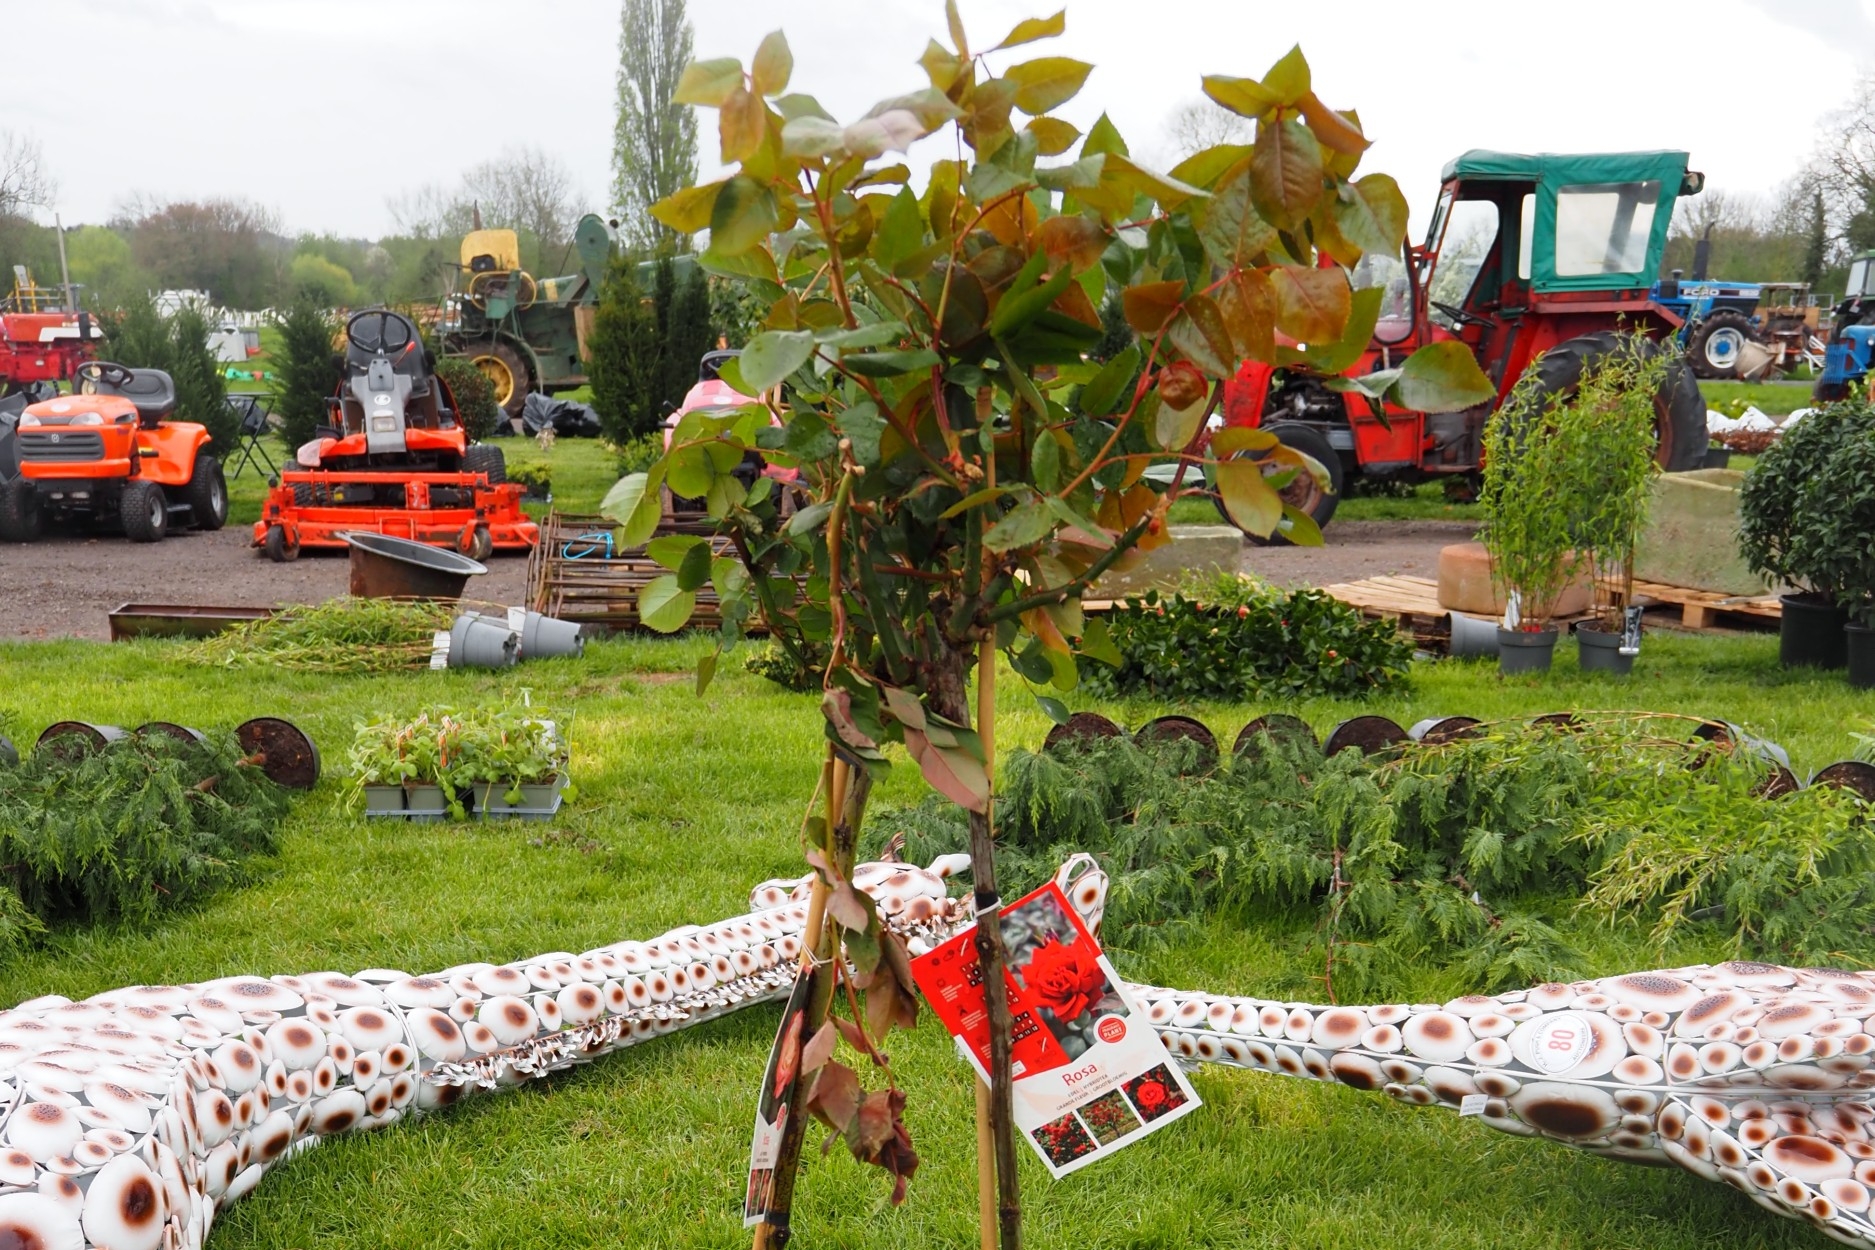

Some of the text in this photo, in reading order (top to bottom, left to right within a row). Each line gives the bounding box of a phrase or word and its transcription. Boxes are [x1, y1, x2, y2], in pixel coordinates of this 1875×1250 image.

[1683, 288, 1720, 296] FORD
[1548, 1030, 1575, 1051] 80
[1062, 1064, 1098, 1086] Rosa
